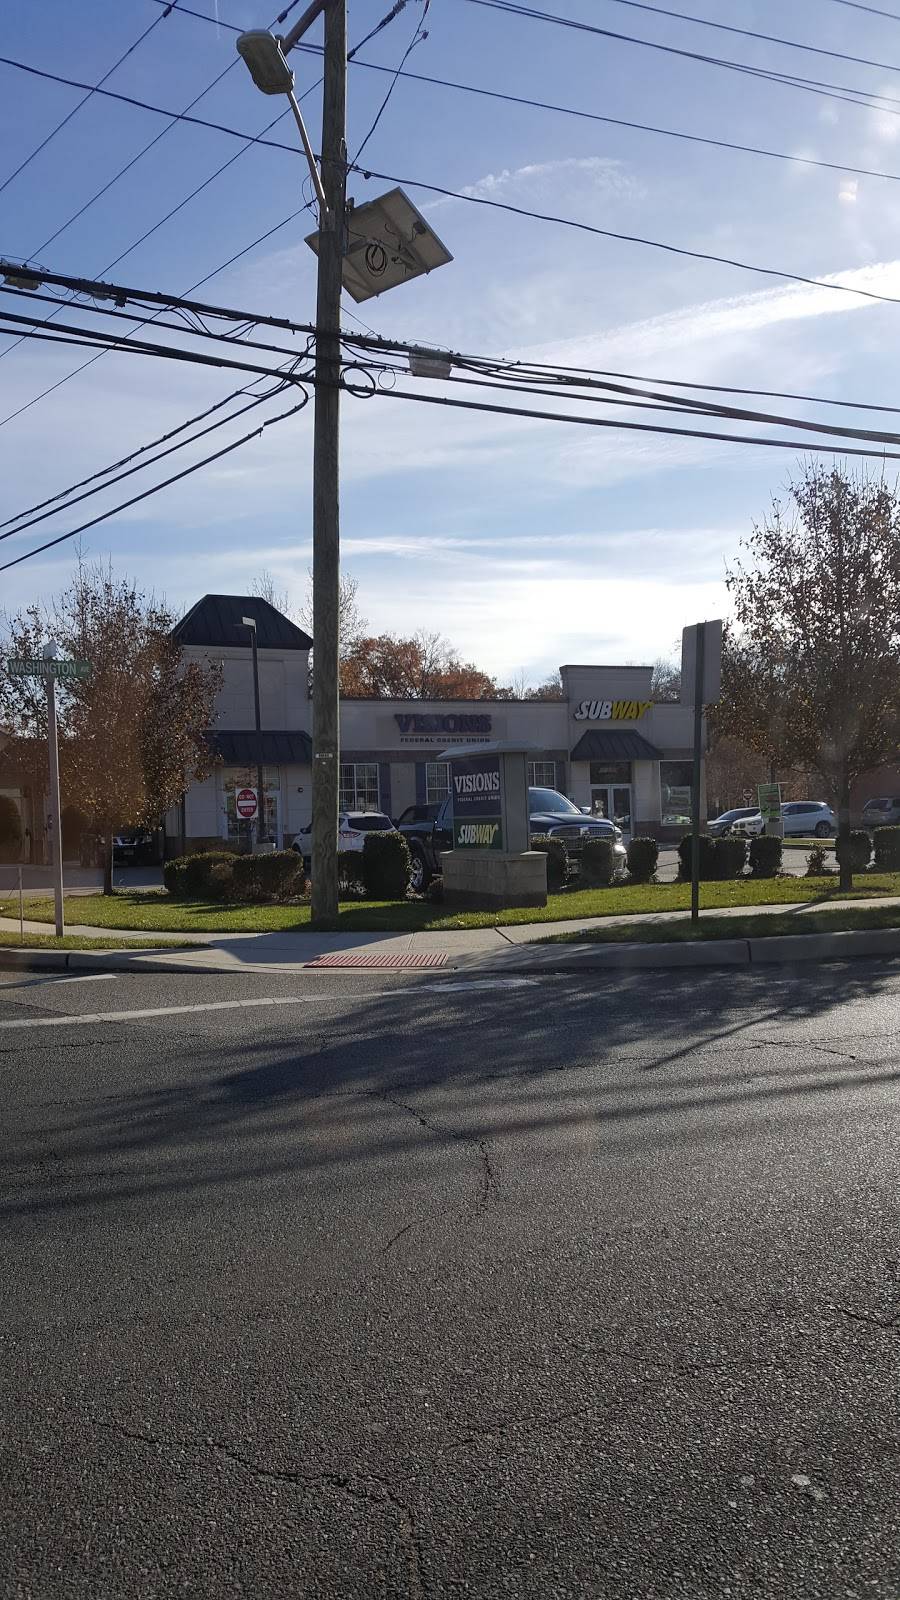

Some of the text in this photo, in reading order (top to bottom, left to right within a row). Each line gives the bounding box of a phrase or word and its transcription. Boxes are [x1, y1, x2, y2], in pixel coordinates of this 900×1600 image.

[10, 661, 77, 675] WASHINGTON
[574, 700, 652, 720] SUBWAY
[393, 714, 493, 733] VISIONS
[453, 771, 500, 793] VISIONS
[458, 824, 499, 844] SUBWAY
